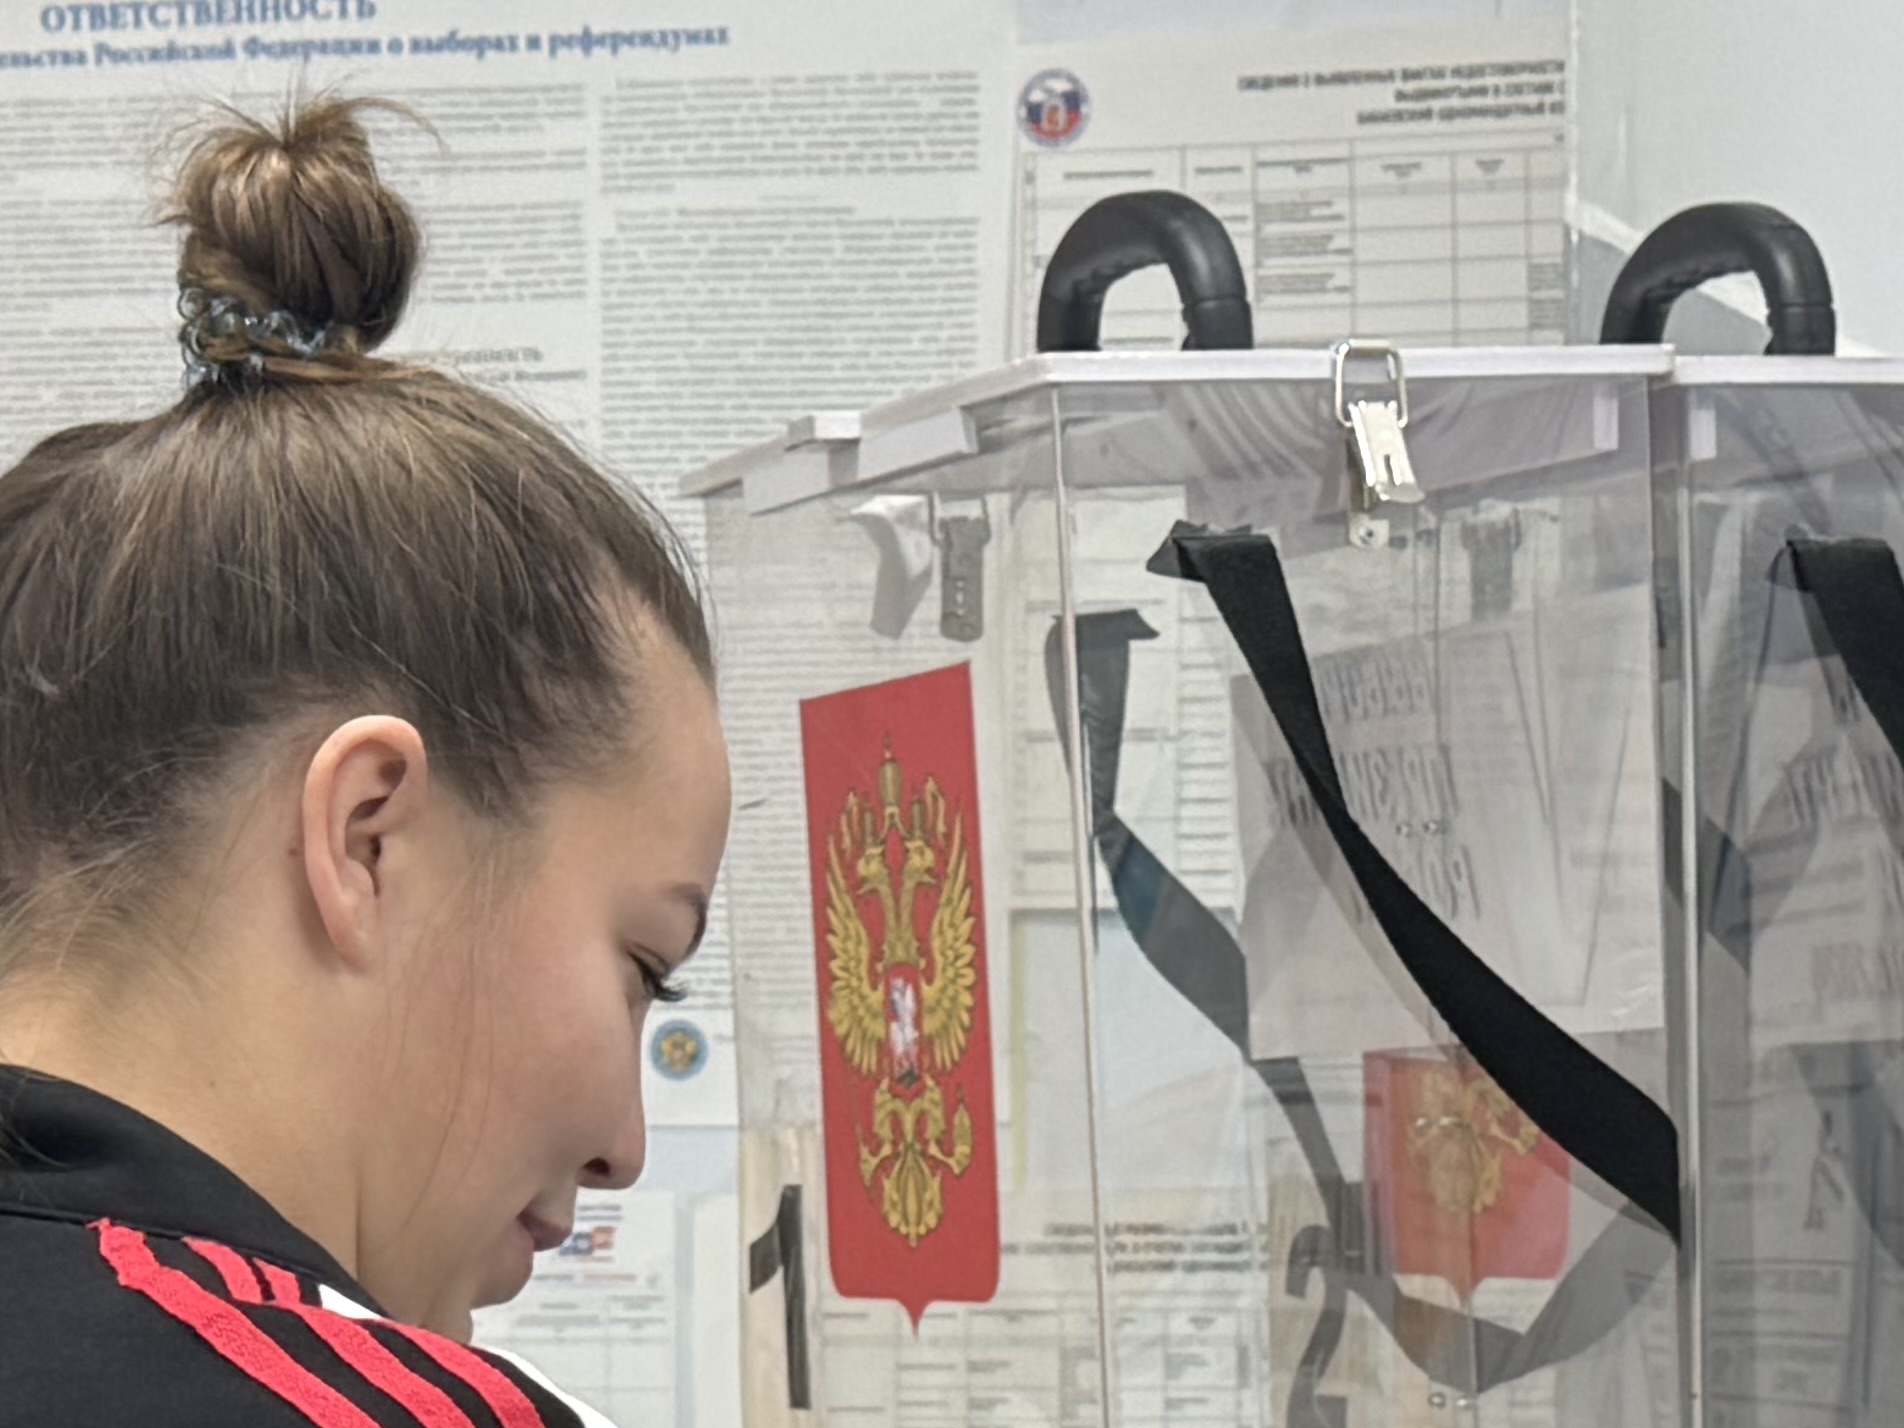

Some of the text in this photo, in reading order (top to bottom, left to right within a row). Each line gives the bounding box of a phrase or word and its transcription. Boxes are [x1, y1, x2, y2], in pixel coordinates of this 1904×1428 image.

[41, 0, 376, 34] ОТВЕТСТВЕННОСТЬ
[93, 40, 234, 67] Российской
[241, 35, 382, 61] Федерации
[409, 29, 519, 59] выборах
[549, 24, 730, 58] референдумах
[749, 1184, 811, 1410] 1
